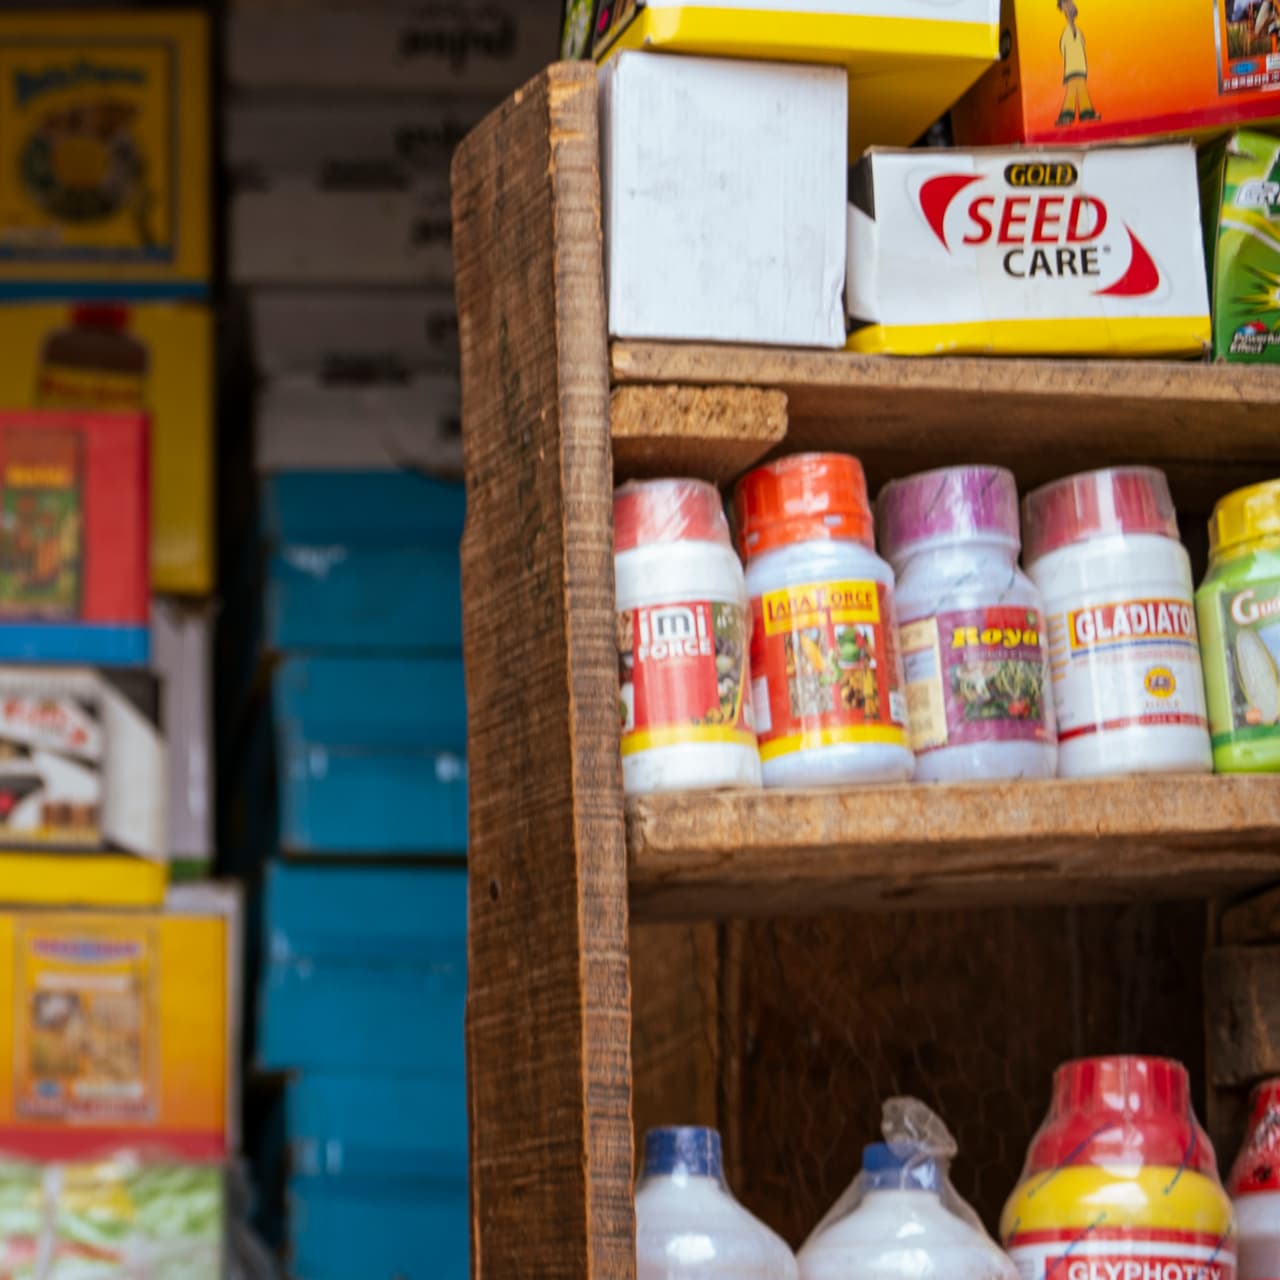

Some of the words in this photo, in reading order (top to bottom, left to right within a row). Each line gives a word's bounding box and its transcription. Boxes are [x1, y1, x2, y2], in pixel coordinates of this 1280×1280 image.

[1008, 164, 1074, 186] GOLD
[964, 196, 1107, 246] SEED
[1002, 247, 1101, 279] CARE
